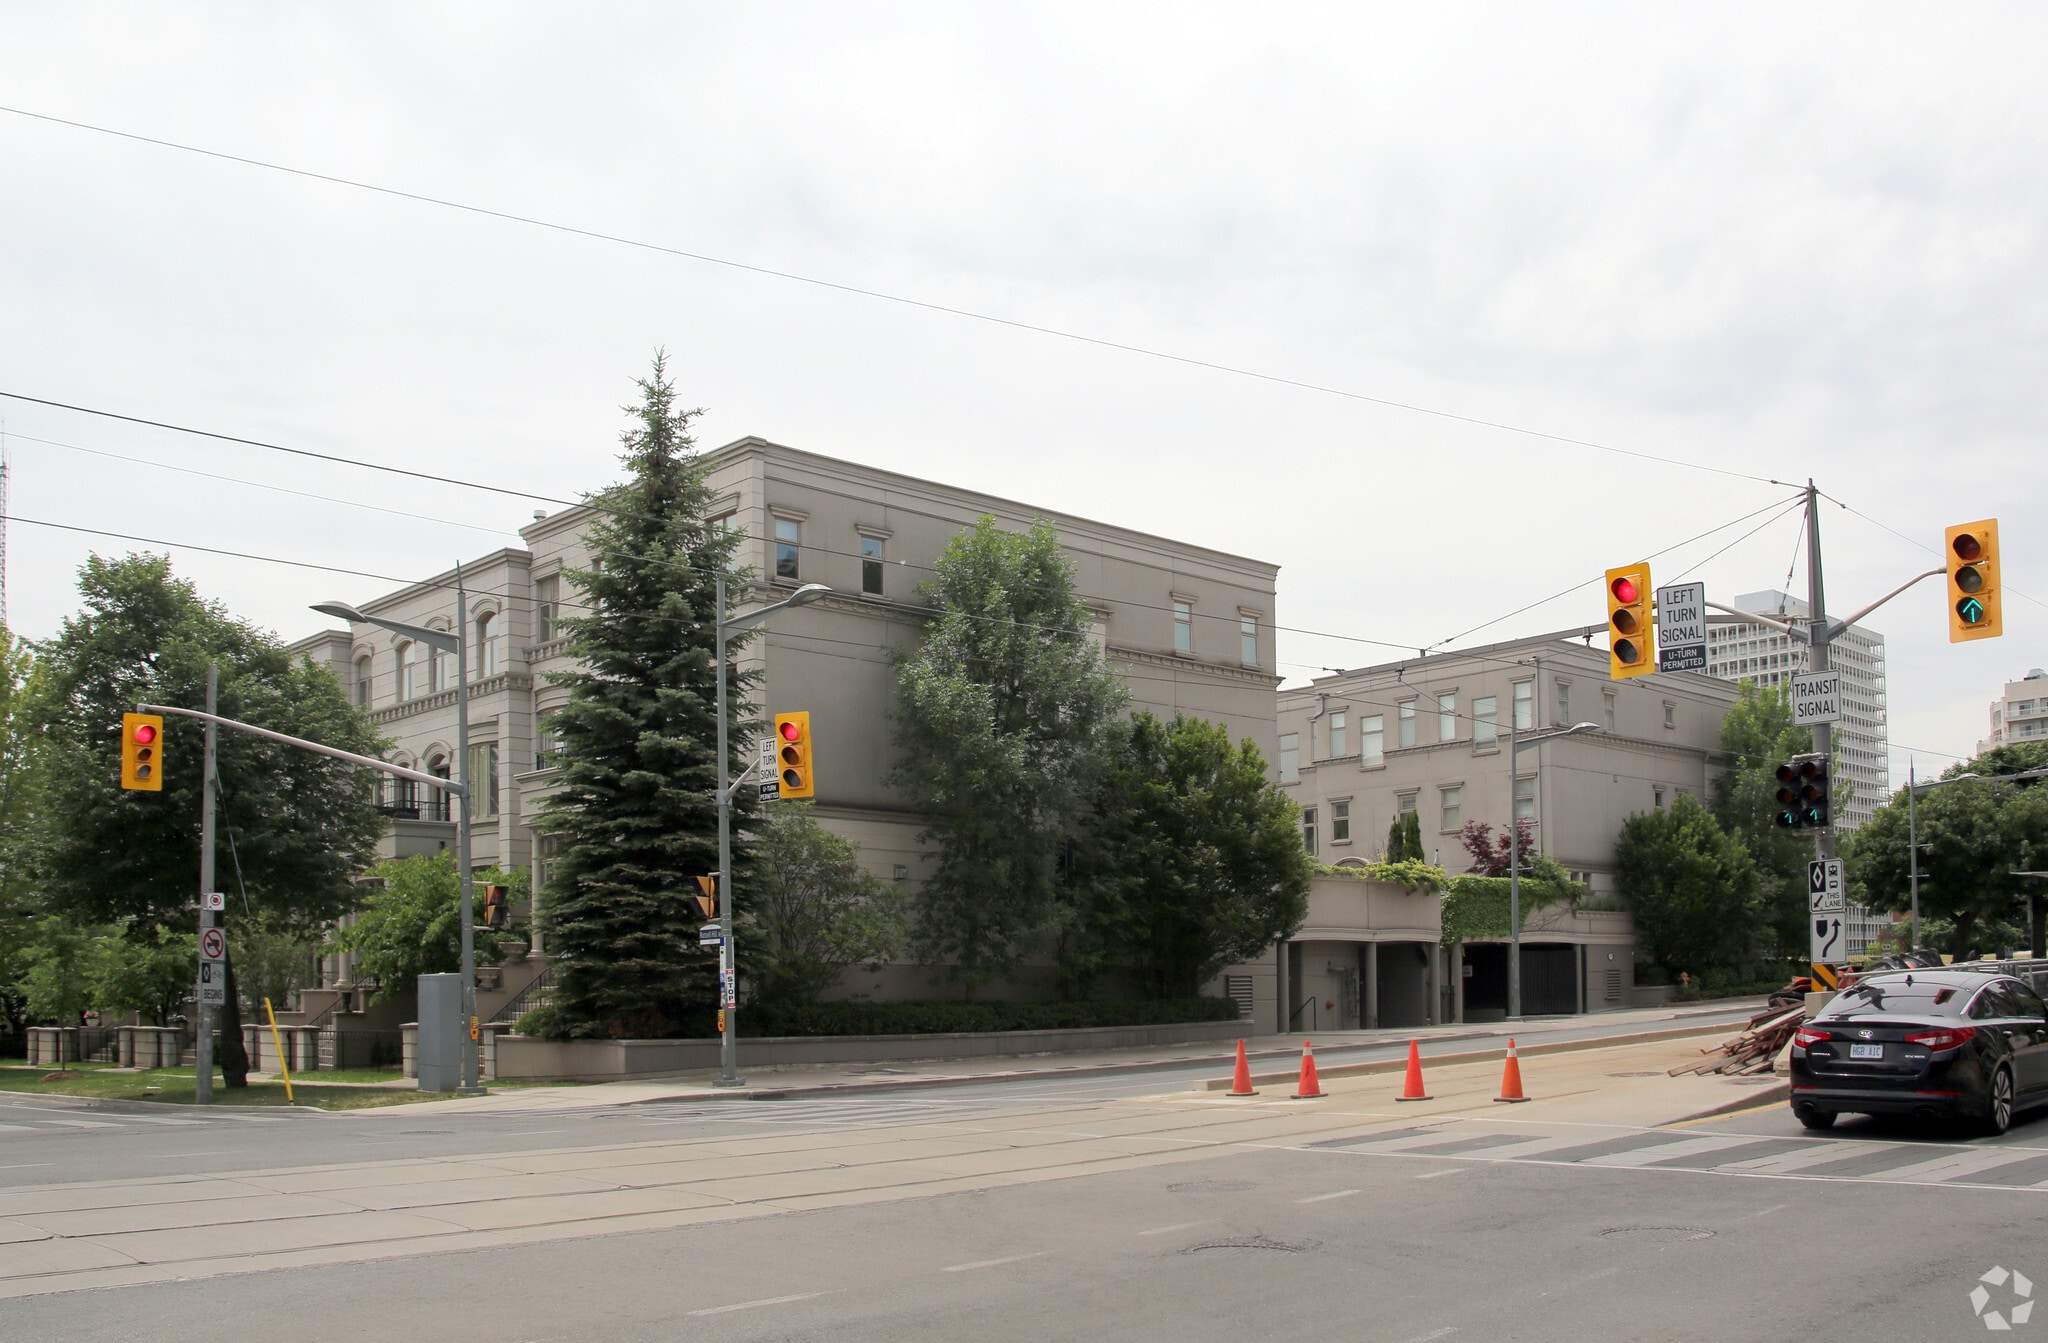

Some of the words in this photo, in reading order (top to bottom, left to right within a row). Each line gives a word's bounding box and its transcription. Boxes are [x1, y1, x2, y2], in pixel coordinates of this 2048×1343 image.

[1666, 588, 1694, 605] LEFT
[1666, 607, 1697, 623] TURN
[1661, 625, 1703, 643] SIGNAL
[1668, 648, 1697, 659] U-TURN
[1662, 657, 1704, 670] PERMITTED
[1794, 678, 1838, 698] TRANSIT
[1797, 699, 1836, 717] SIGNAL
[763, 741, 775, 752] LEFT
[763, 755, 776, 766] TURN
[761, 768, 778, 780] SIGNAL
[1826, 891, 1840, 900] THIS
[1824, 900, 1842, 908] LANE
[204, 989, 222, 1000] BEGINS
